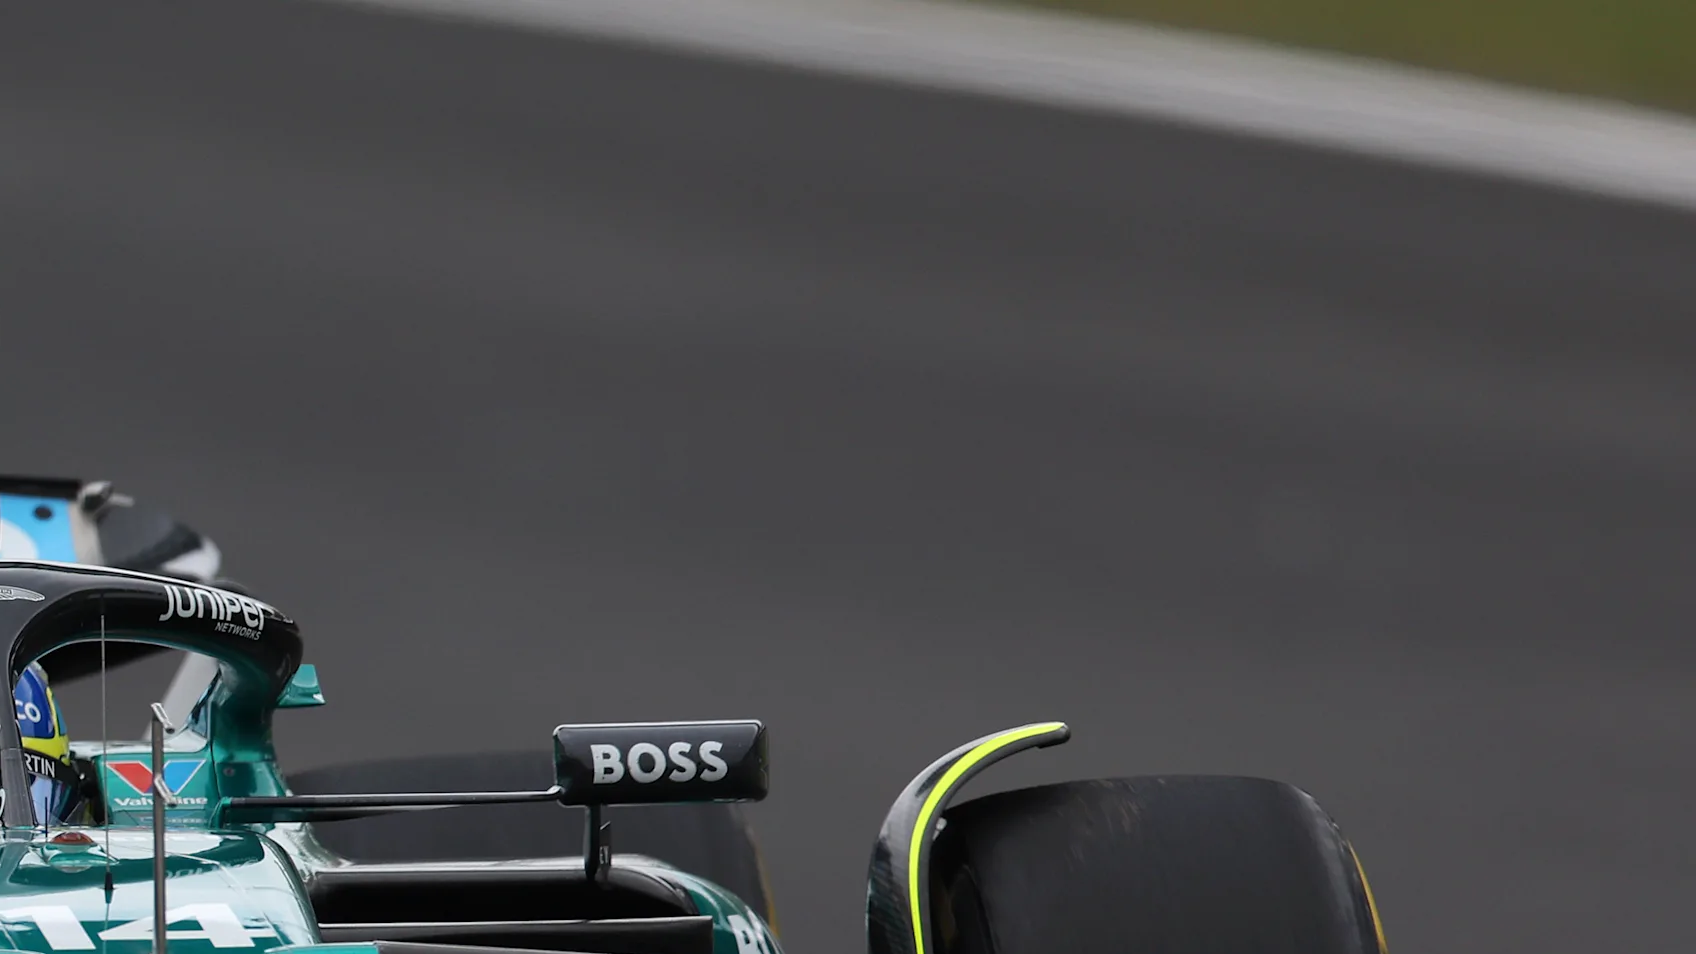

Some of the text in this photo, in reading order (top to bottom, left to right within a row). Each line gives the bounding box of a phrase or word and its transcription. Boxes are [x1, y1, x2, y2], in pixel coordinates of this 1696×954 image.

[215, 622, 262, 641] NETWORKS
[24, 753, 55, 778] RTIN
[590, 741, 728, 784] BOSS
